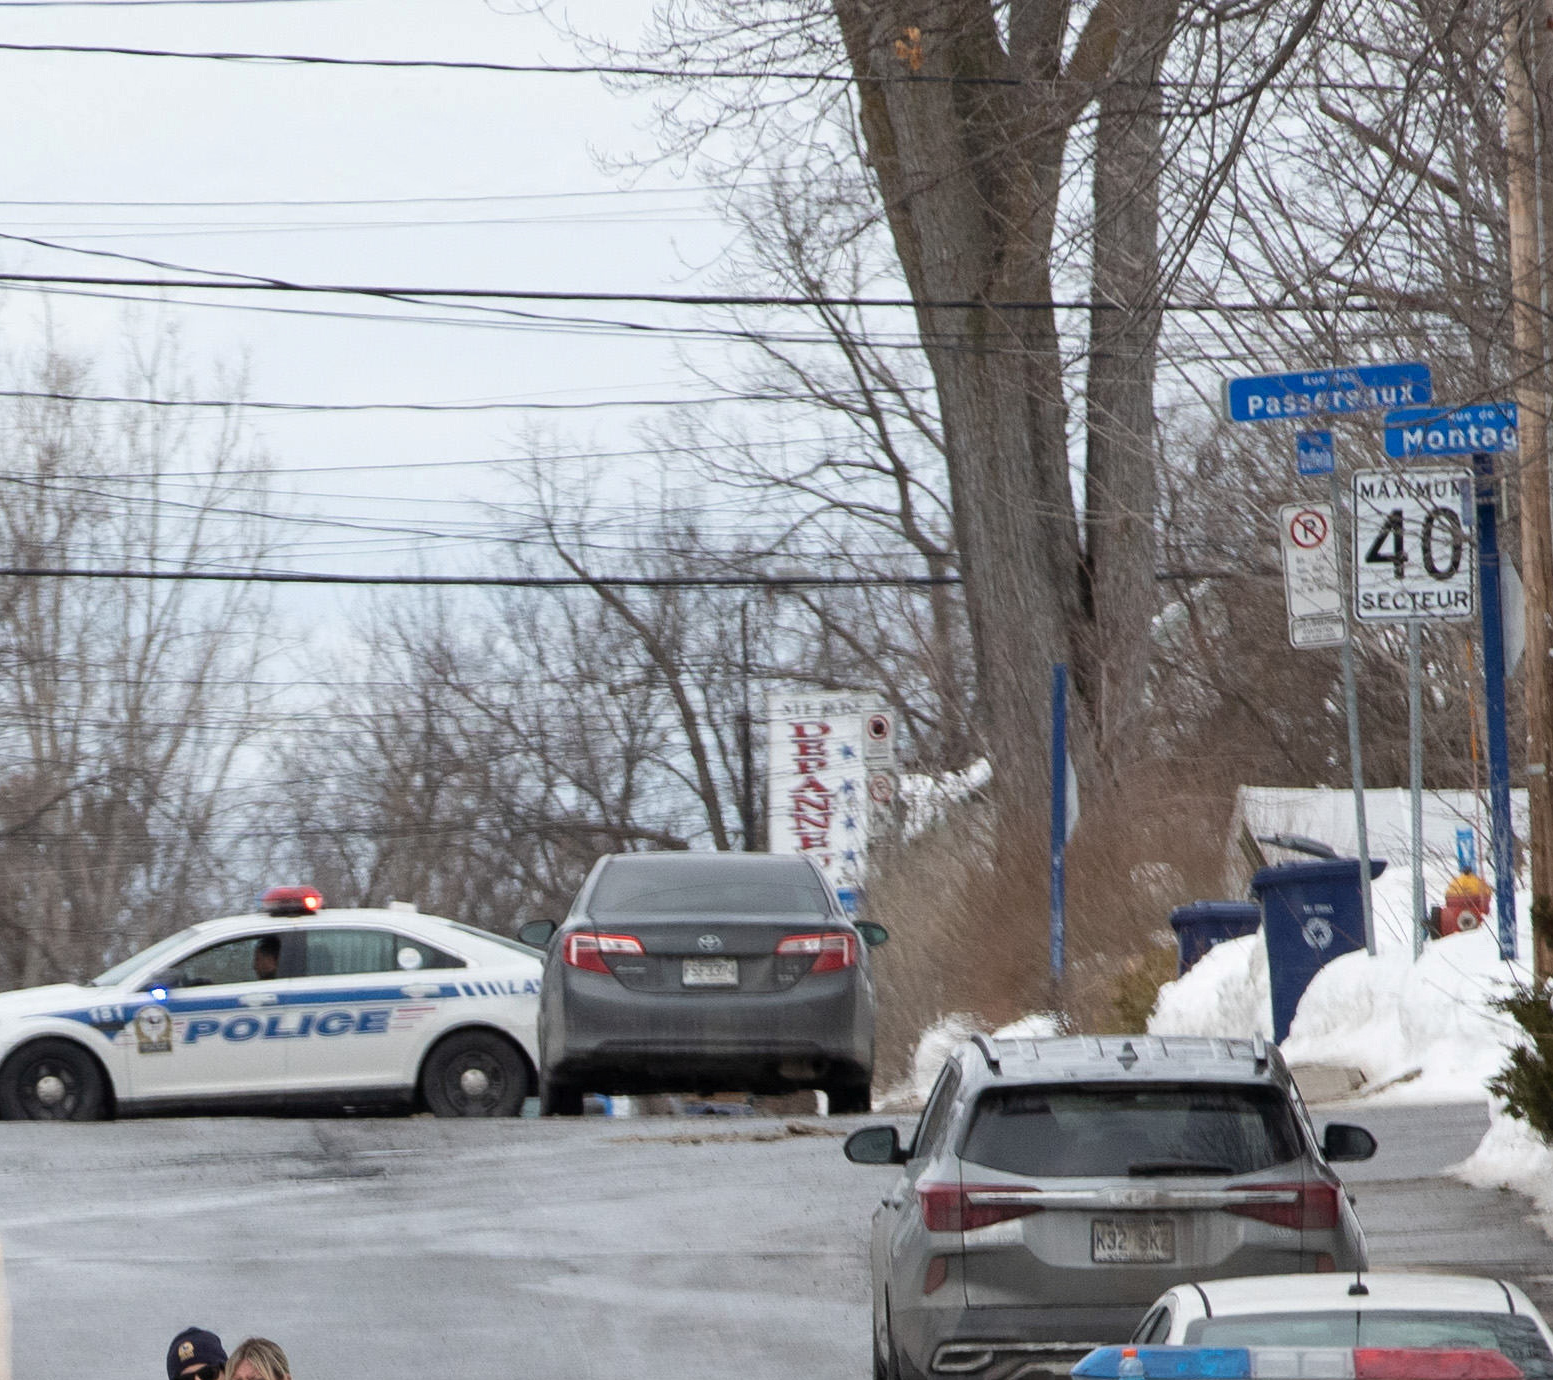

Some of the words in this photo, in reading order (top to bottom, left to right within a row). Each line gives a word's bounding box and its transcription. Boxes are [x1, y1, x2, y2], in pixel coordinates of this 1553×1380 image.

[1302, 374, 1325, 386] Rue
[1248, 383, 1414, 417] Passereaux
[1448, 410, 1472, 422] Rue
[1478, 408, 1495, 421] de
[1402, 424, 1518, 451] Montag
[1365, 507, 1463, 581] 40
[1361, 591, 1469, 611] SECTEUR
[788, 719, 837, 867] DEPANNE
[181, 1007, 395, 1045] POLICE
